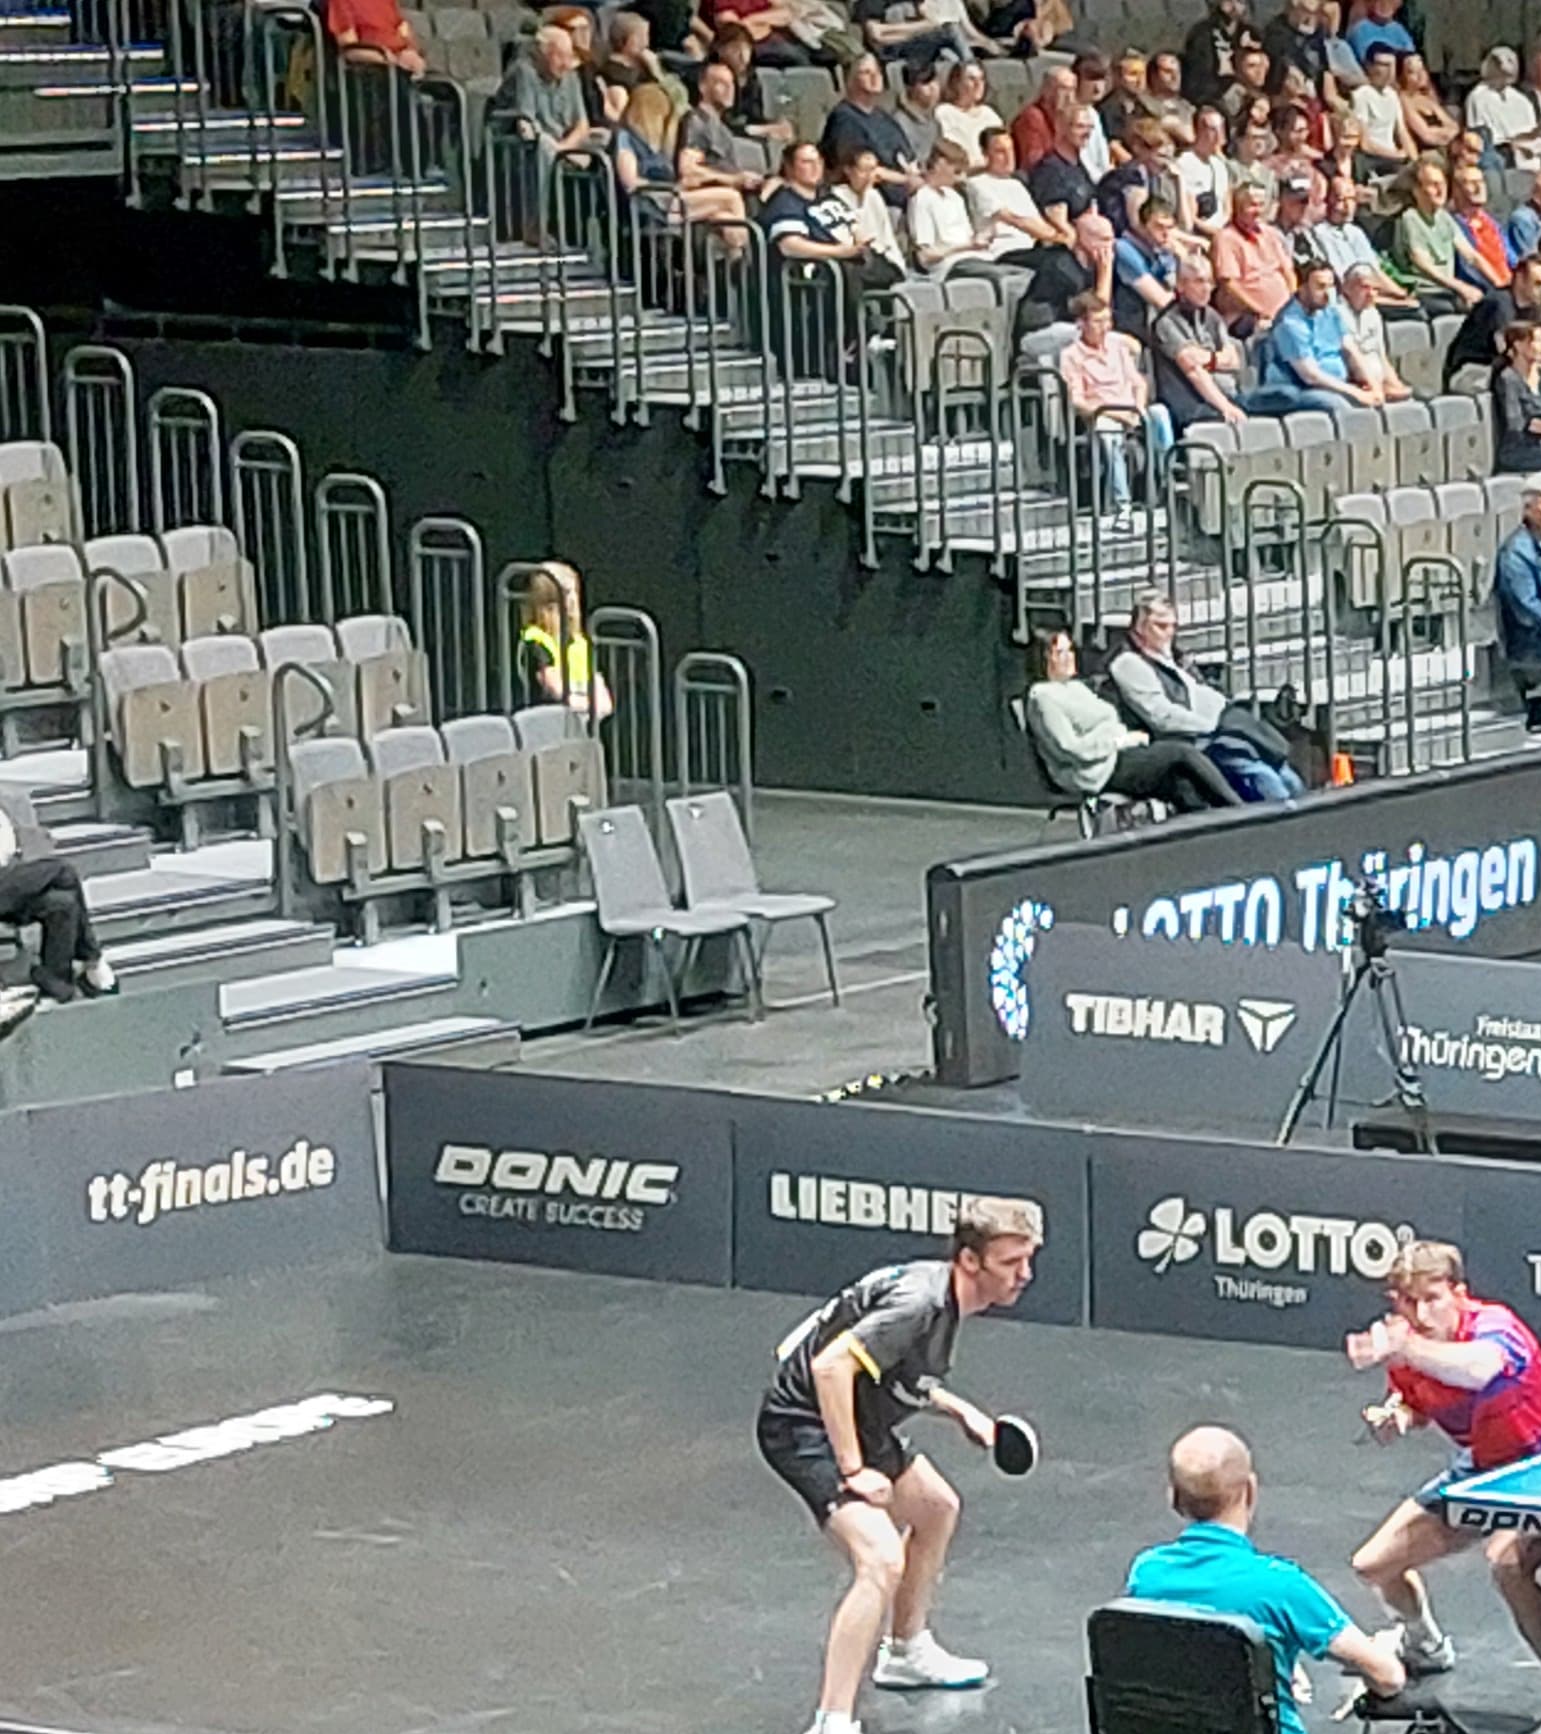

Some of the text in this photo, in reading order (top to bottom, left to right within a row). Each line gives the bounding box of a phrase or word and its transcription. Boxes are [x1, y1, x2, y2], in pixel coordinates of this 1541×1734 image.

[1064, 992, 1226, 1047] TIBHAR
[87, 1141, 335, 1226] tt-finals.de
[434, 1143, 680, 1205] DONIC
[770, 1173, 1043, 1237] LIEBHE
[458, 1193, 645, 1231] CREATE SUCCESS
[1214, 1207, 1399, 1279] LOTTO
[1214, 1275, 1307, 1306] Thüringen
